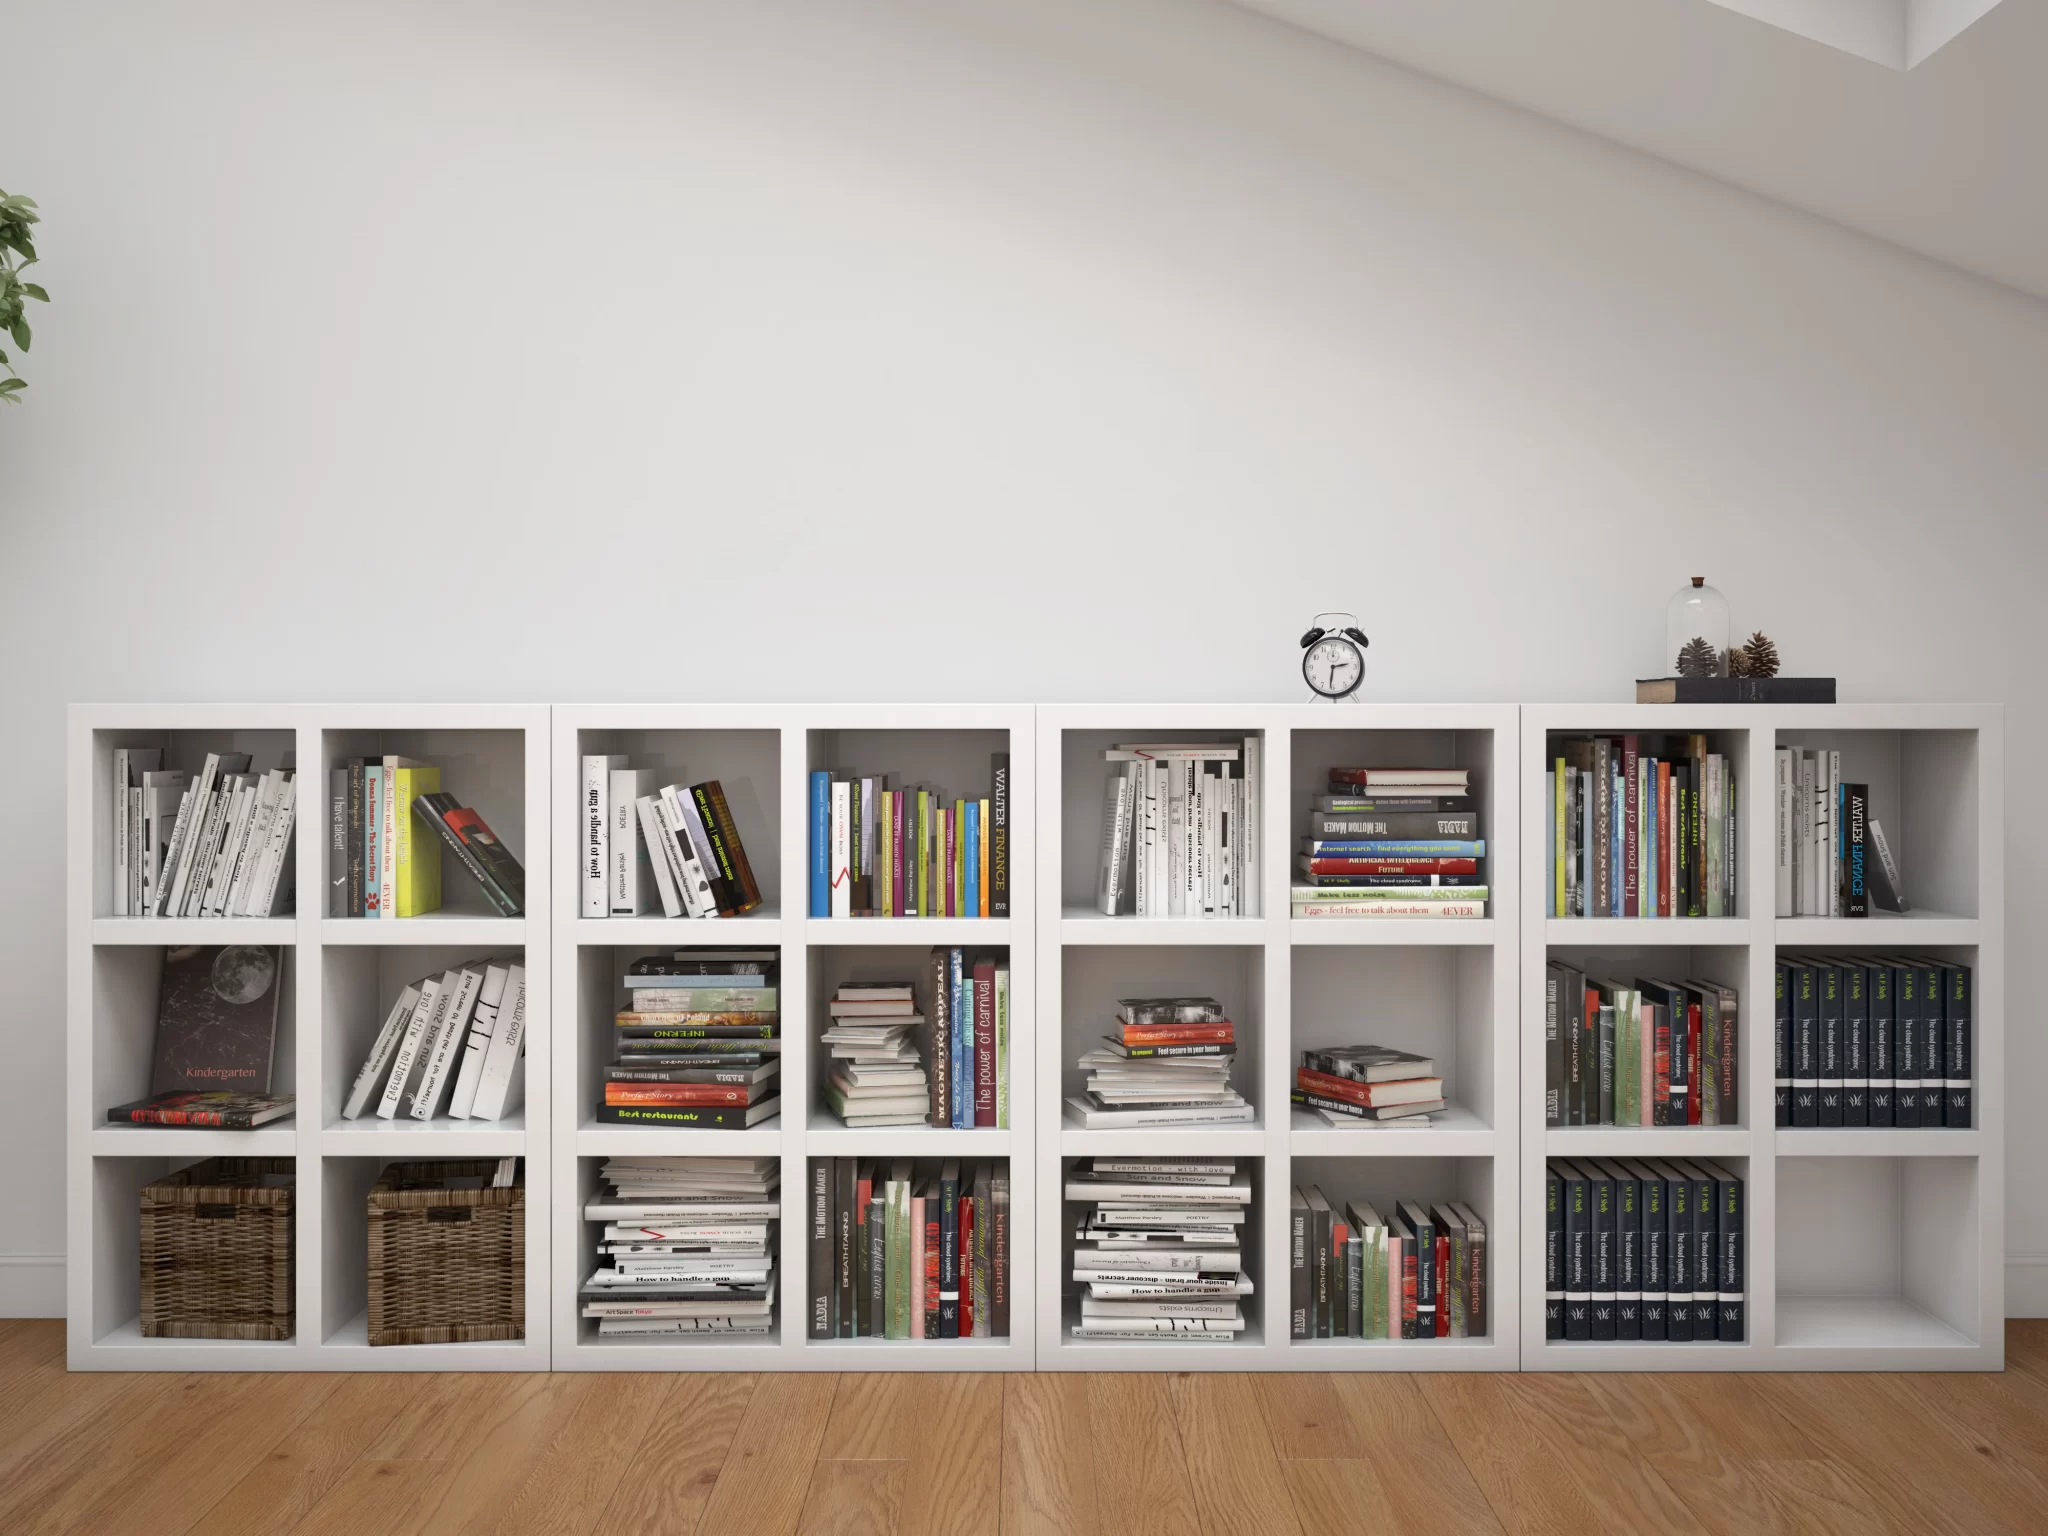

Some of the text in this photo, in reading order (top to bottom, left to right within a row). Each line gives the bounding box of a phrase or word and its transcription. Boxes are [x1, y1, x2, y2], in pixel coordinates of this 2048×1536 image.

[385, 765, 393, 781] Eggs
[996, 768, 1005, 825] WALTER
[264, 793, 284, 849] Unicorns exists
[334, 802, 344, 821] have
[385, 814, 391, 822] to
[1625, 751, 1638, 899] The power of carnival
[334, 824, 345, 850] talent!
[1324, 822, 1387, 834] THE MOTION MAKER
[996, 828, 1005, 890] FINANCE
[1876, 834, 1896, 880] Sun and Snow
[368, 866, 376, 882] Story
[382, 882, 390, 910] 4EVER
[1304, 906, 1323, 916] Eggs
[1441, 907, 1473, 916] 4EVER
[1904, 986, 1912, 1000] Shelly
[975, 980, 995, 1112] The power of carnival
[1158, 1047, 1168, 1055] Feel
[1722, 1020, 1732, 1096] Kindergarten
[186, 1068, 256, 1079] Kindergarten
[618, 1110, 698, 1120] Best restaurants
[815, 1169, 826, 1239] THE MOTION MAKER
[1727, 1200, 1735, 1213] Shelly
[873, 1238, 884, 1299] English circus
[994, 1214, 1005, 1303] Kindergarten
[1470, 1249, 1481, 1313] Kindergarten
